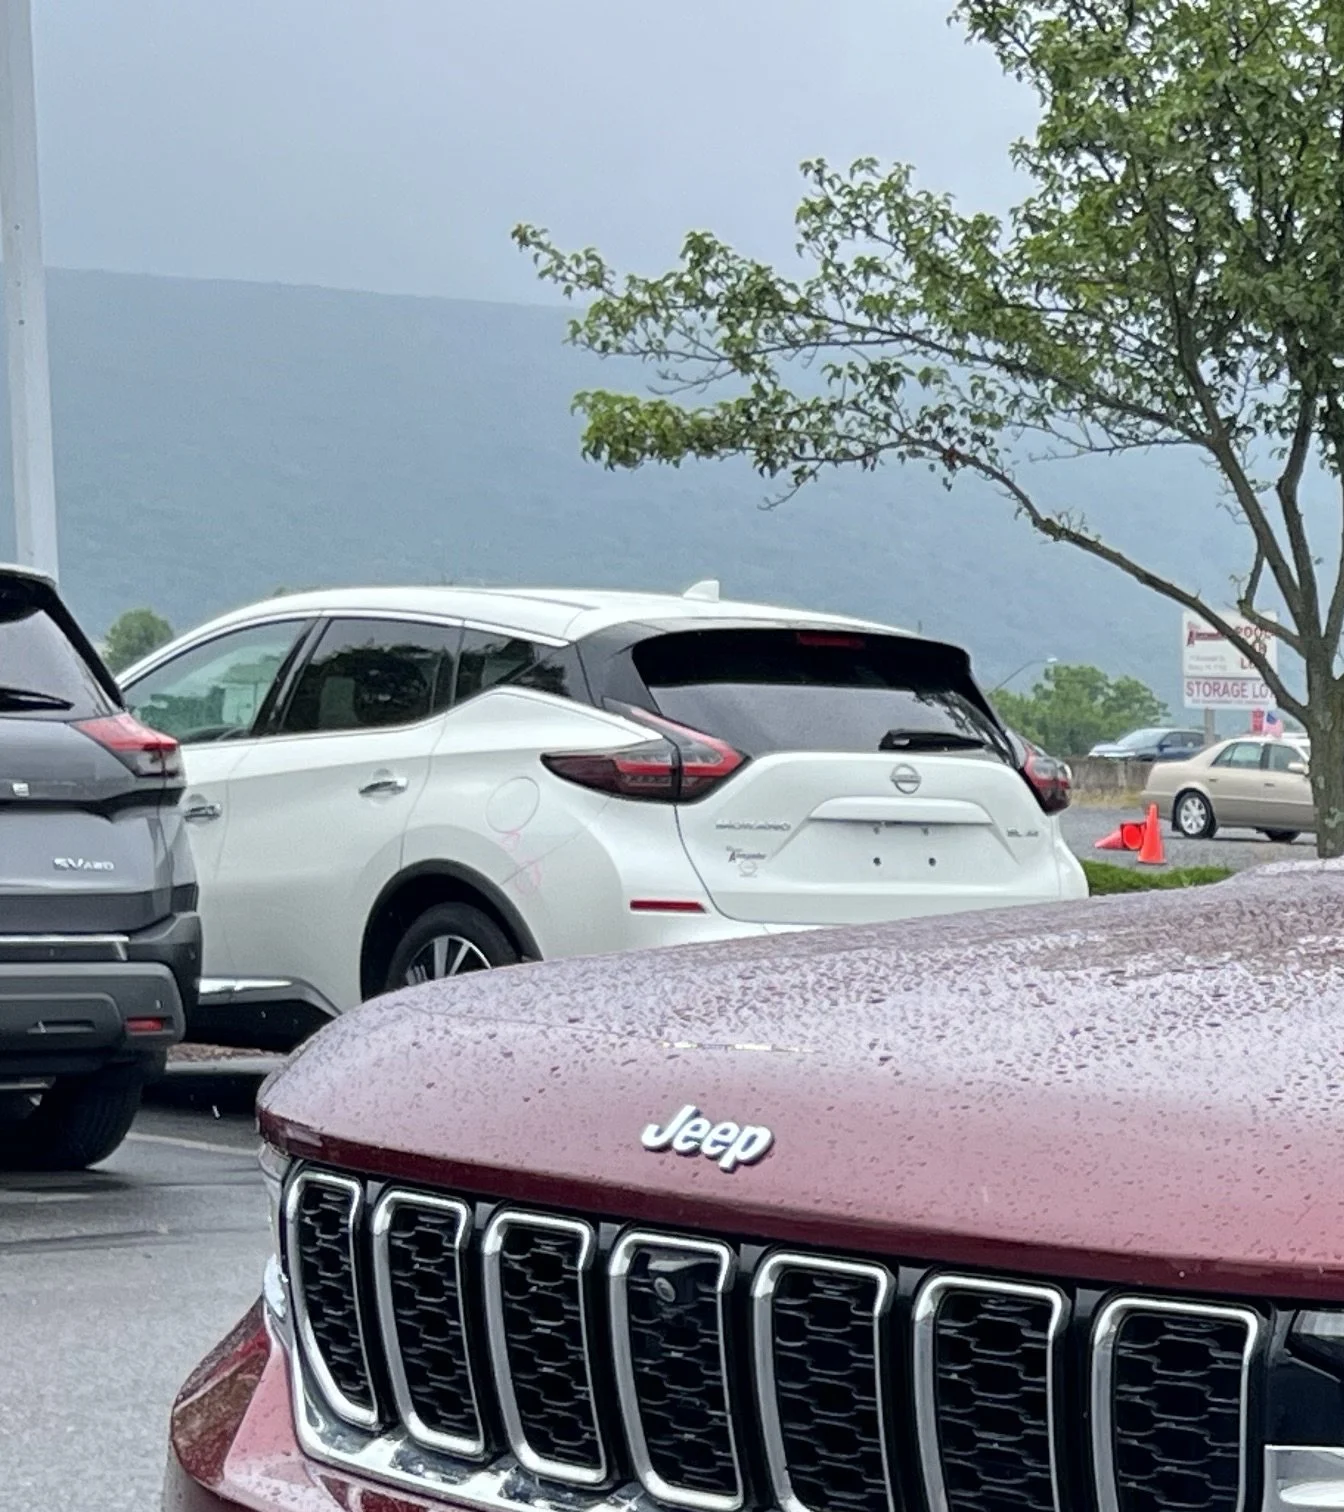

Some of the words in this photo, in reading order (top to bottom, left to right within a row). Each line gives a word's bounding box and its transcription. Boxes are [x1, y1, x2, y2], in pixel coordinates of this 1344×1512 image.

[1185, 681, 1249, 698] STORAGE
[1252, 682, 1276, 698] LO
[640, 1104, 774, 1171] Jeep
